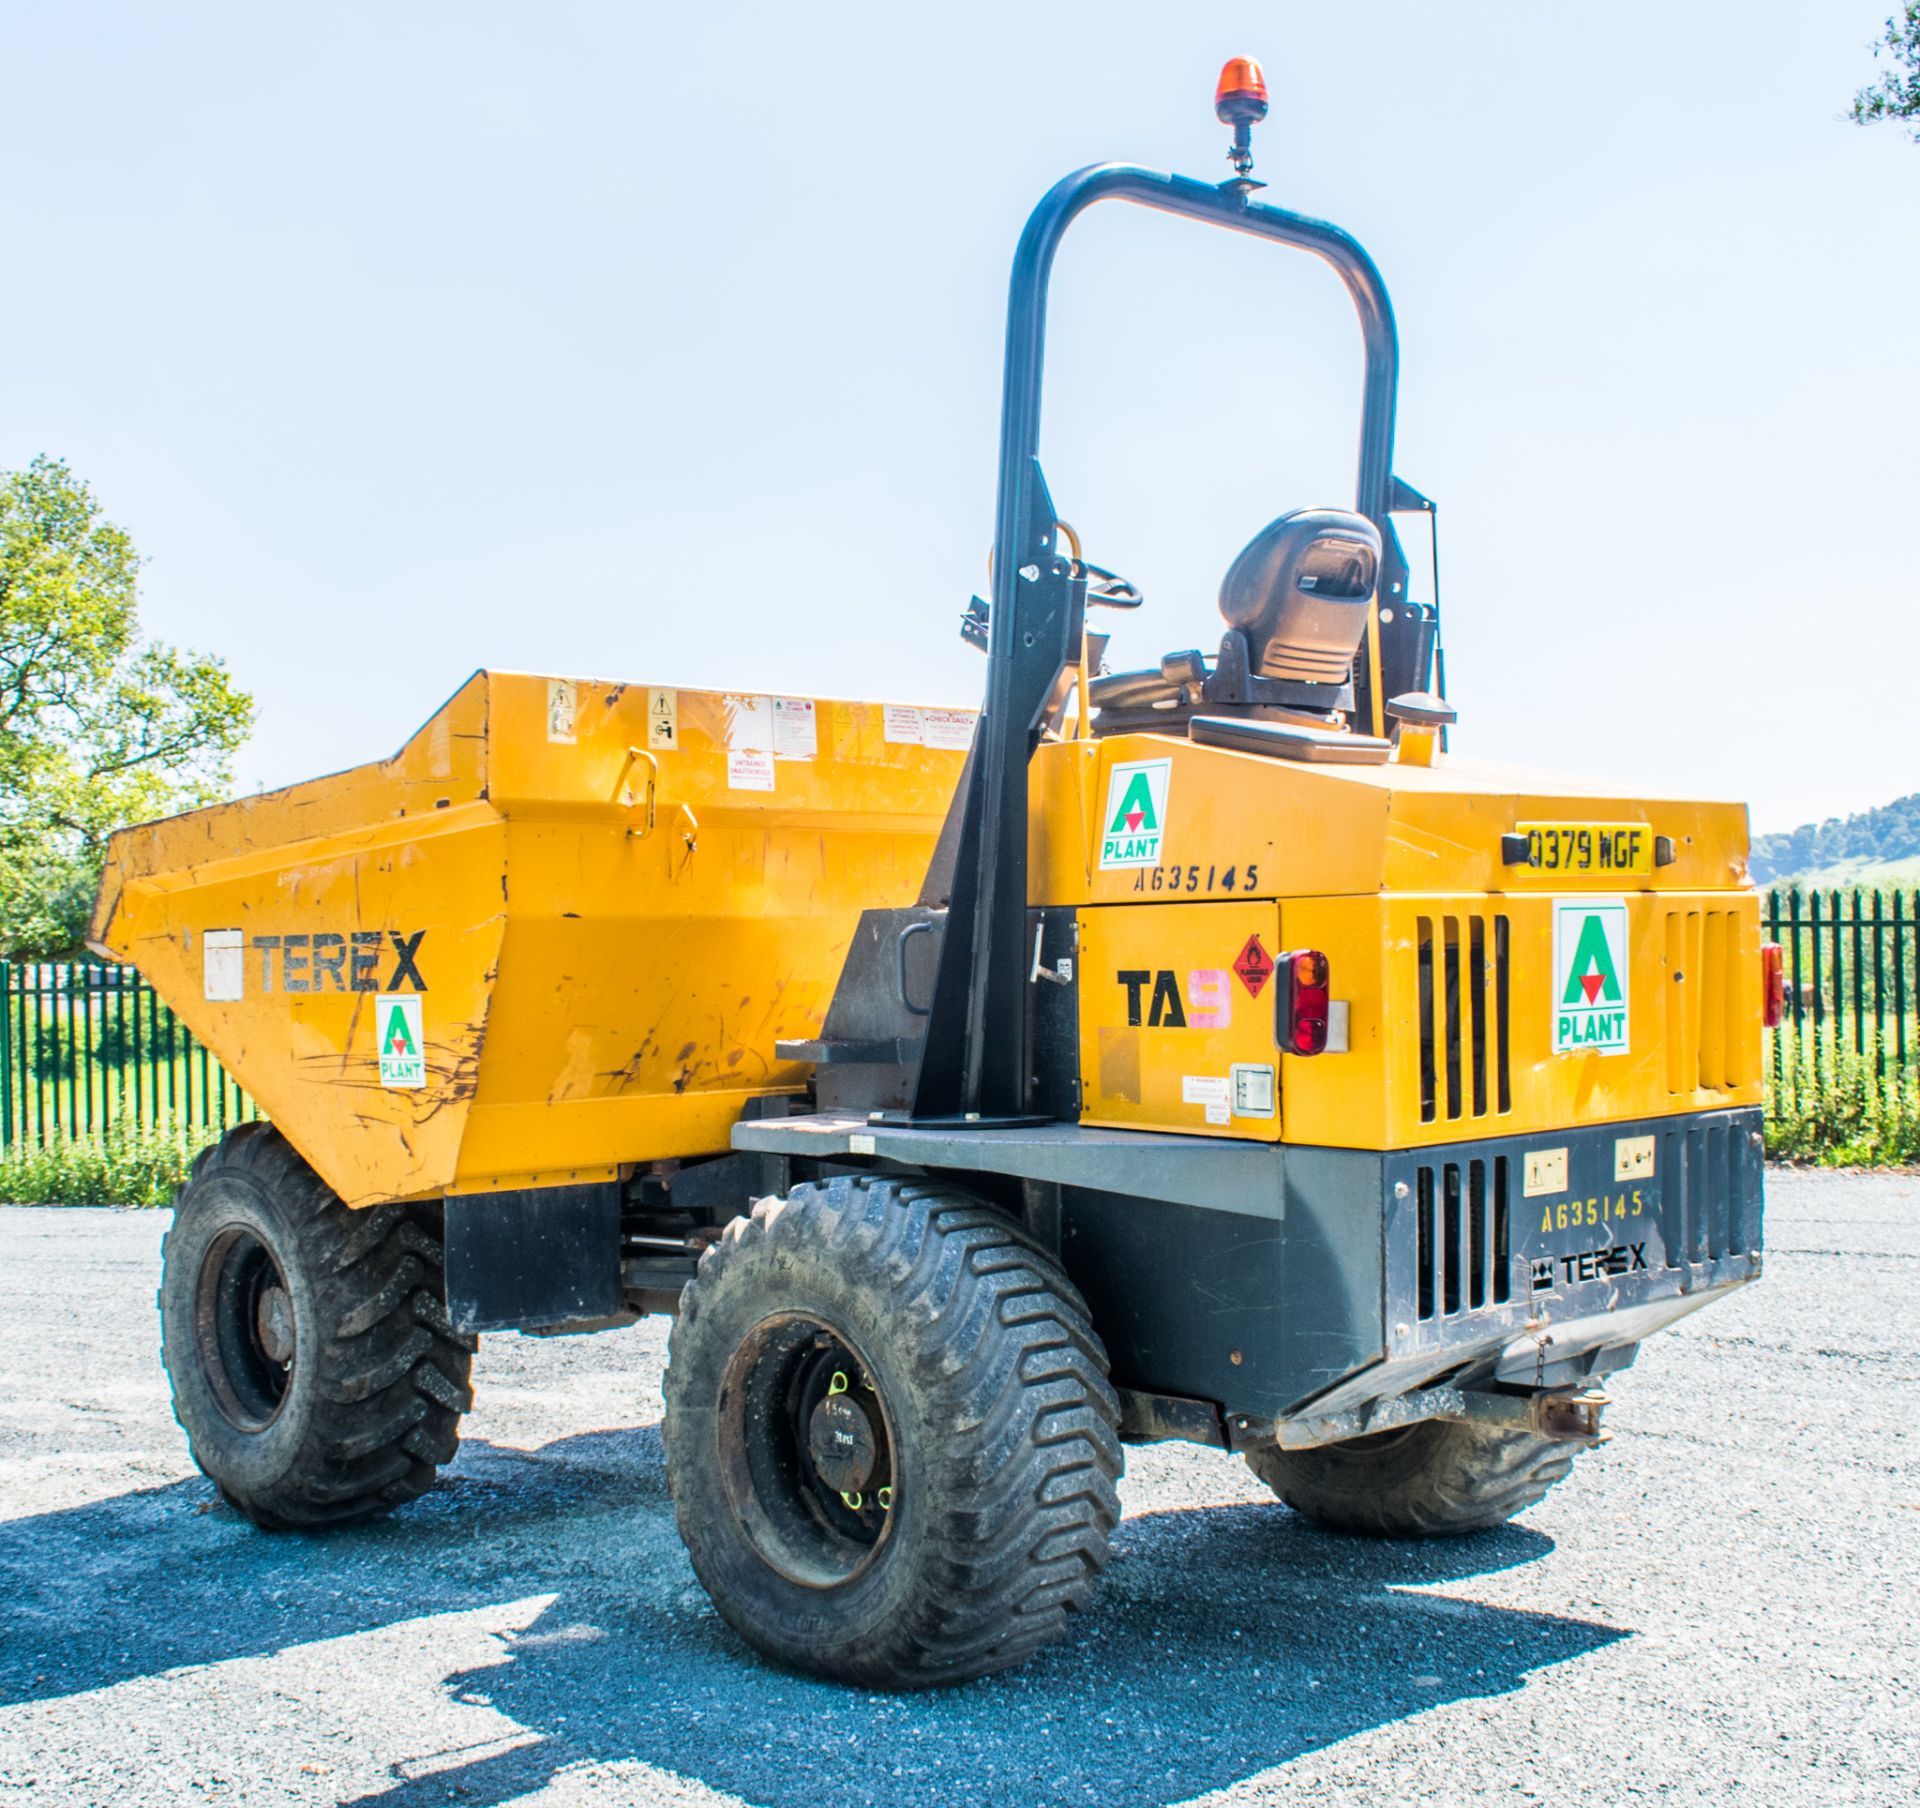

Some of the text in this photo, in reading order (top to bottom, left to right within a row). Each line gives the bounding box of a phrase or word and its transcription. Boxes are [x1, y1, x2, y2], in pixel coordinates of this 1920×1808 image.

[1110, 773, 1158, 833] A
[1103, 838, 1159, 860] PLANT
[1134, 865, 1259, 892] A635145
[253, 929, 428, 993] TEREX
[1563, 915, 1622, 1003] A
[1117, 970, 1231, 1029] TA9
[383, 1005, 417, 1056] A
[1558, 1012, 1625, 1044] PLANT
[381, 1062, 422, 1079] PLANT
[1541, 1190, 1643, 1233] A635145
[1560, 1242, 1649, 1284] TEREX
